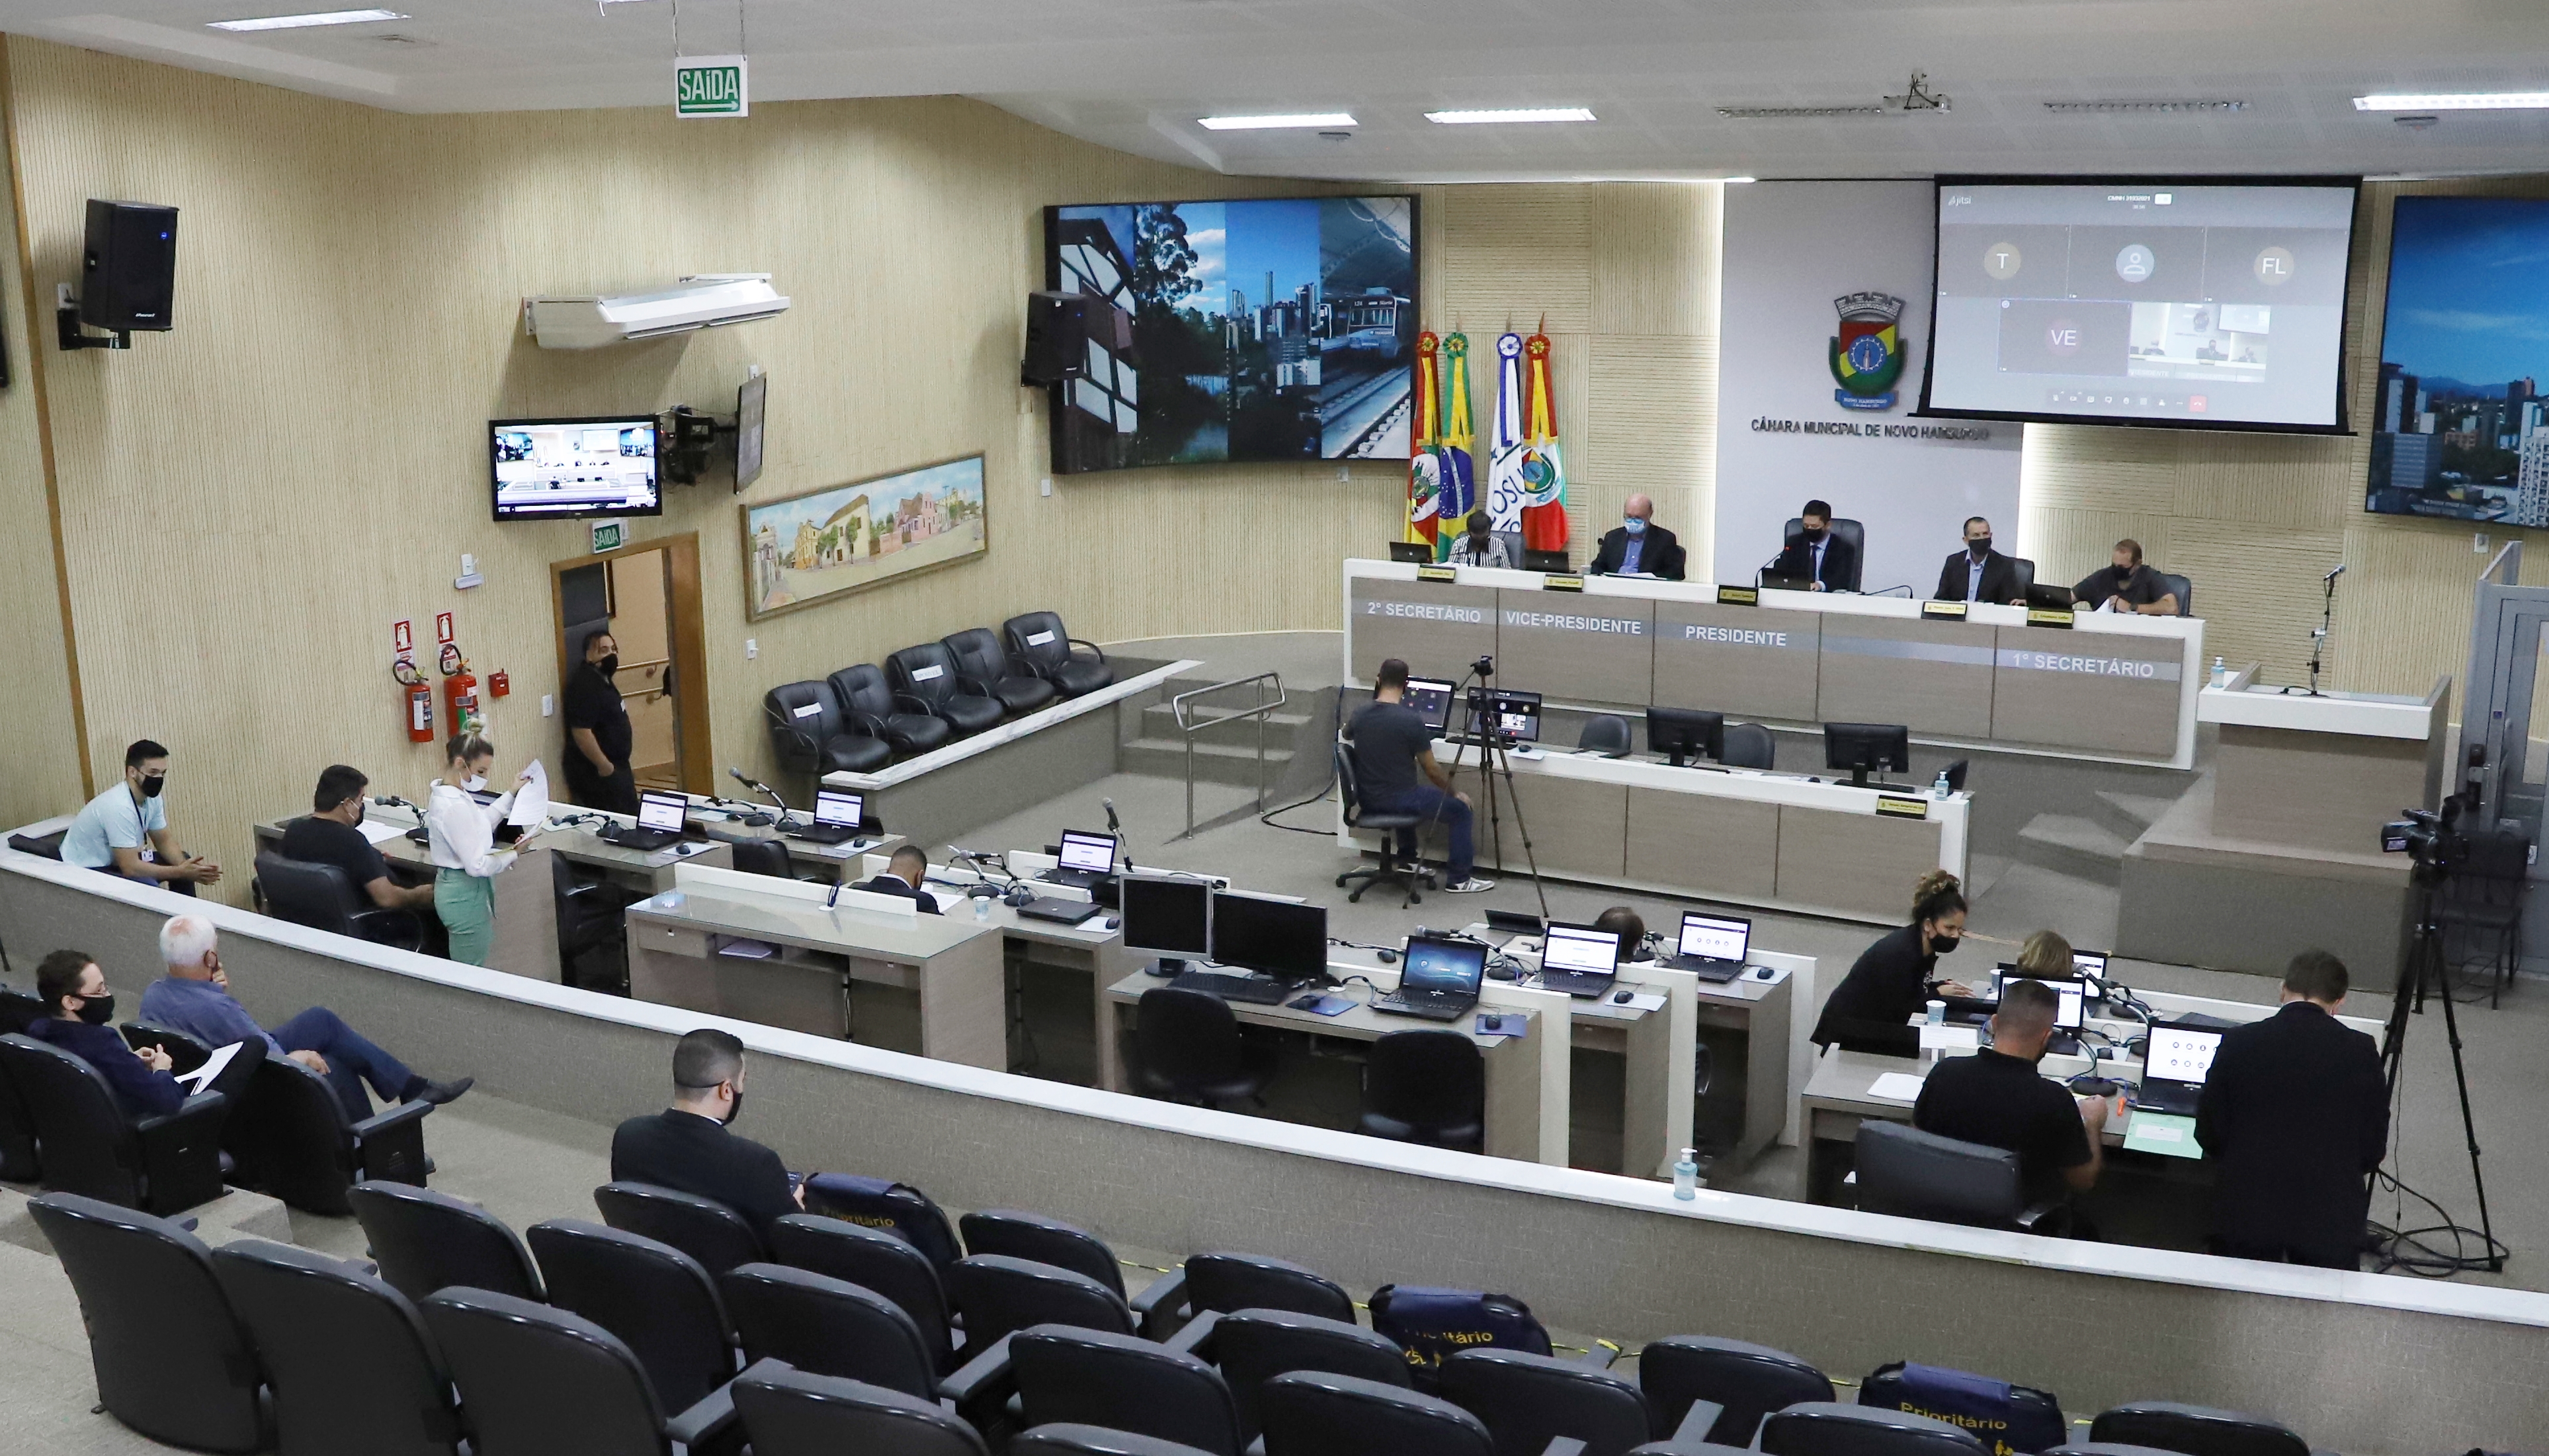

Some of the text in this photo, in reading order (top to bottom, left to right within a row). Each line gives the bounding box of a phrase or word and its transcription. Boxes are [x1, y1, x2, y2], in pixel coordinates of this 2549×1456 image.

[679, 69, 739, 101] SAÍDA
[1996, 253, 2009, 269] T
[2262, 257, 2286, 274] FL
[2050, 329, 2077, 346] VE
[1751, 416, 1801, 433] CÂMARA
[1804, 421, 1862, 436] MUNICIPAL
[1865, 424, 1880, 437] DE
[1884, 424, 1918, 438] NOVO
[595, 528, 619, 547] SAÍDA
[1386, 602, 1481, 623] SECRETÁRIO
[1506, 611, 1641, 635] VICE-PRESIDENTE
[1685, 625, 1786, 647] PRESIDENTE
[2034, 655, 2154, 678] SECRETÁRIO
[1900, 1401, 2008, 1430] Prioritário
